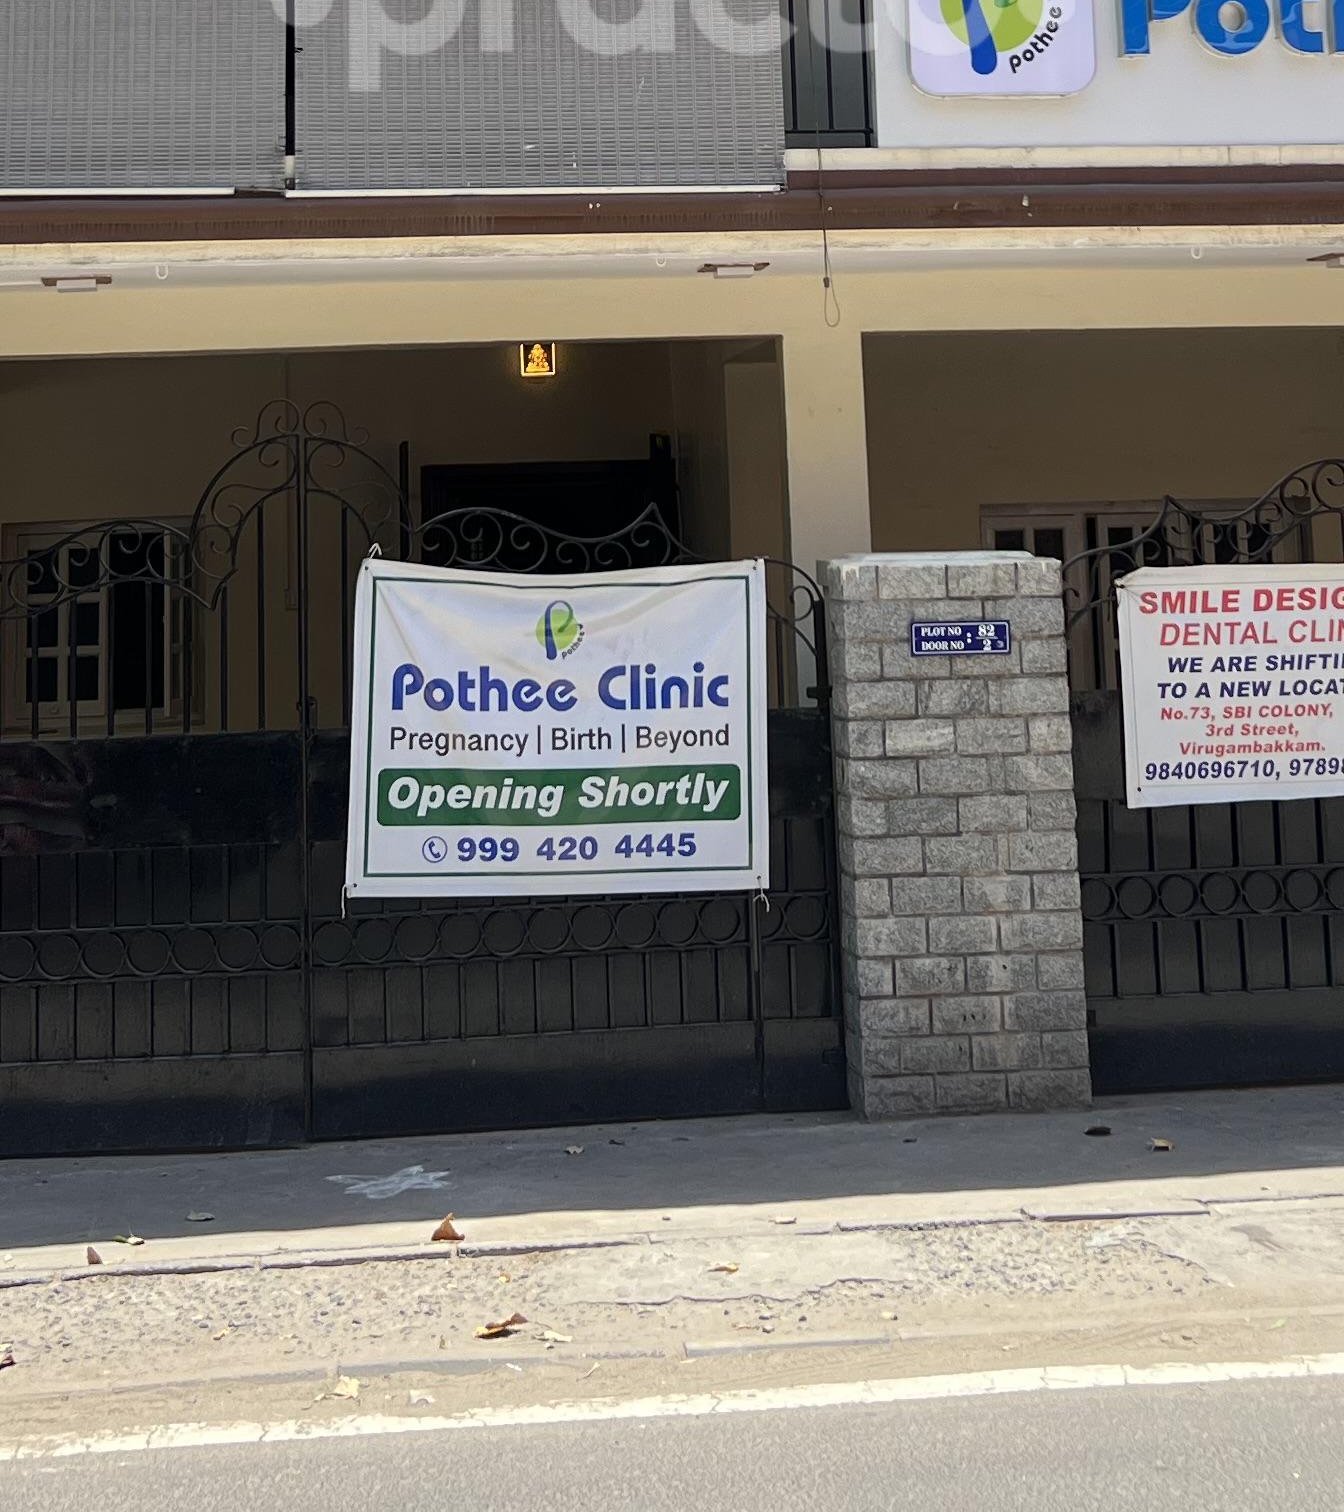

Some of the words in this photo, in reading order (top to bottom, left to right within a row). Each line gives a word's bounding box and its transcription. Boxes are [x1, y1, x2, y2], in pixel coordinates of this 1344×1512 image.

[1139, 589, 1241, 615] SMILE
[921, 626, 946, 637] PLOT
[947, 625, 962, 636] NO
[978, 624, 996, 637] 82
[1160, 620, 1278, 647] DENTAL
[921, 640, 949, 651] DOOR
[949, 640, 965, 650] NO
[982, 639, 992, 651] 2
[1167, 657, 1203, 673] WE
[1211, 655, 1257, 672] ARE
[391, 662, 578, 712] Pothee
[599, 661, 729, 710] Clinic
[1157, 682, 1187, 698] TO
[1195, 682, 1211, 698] A
[1219, 680, 1272, 698] NEW
[1160, 706, 1215, 721] No.73,
[1223, 706, 1252, 719] SBI
[1258, 703, 1334, 718] COLONY,
[389, 725, 529, 757] Pregnancy
[551, 726, 613, 752] Birth
[635, 723, 730, 753] Beyond
[1205, 724, 1234, 737] 3rd
[1241, 723, 1300, 737] Street,
[1179, 739, 1326, 757] Virugambakkam.
[1145, 759, 1280, 781] 9840696710,
[387, 776, 565, 818] Opening
[578, 773, 730, 813] Shortly
[456, 837, 520, 862] 999
[536, 836, 599, 861] 420
[615, 832, 698, 858] 4445
